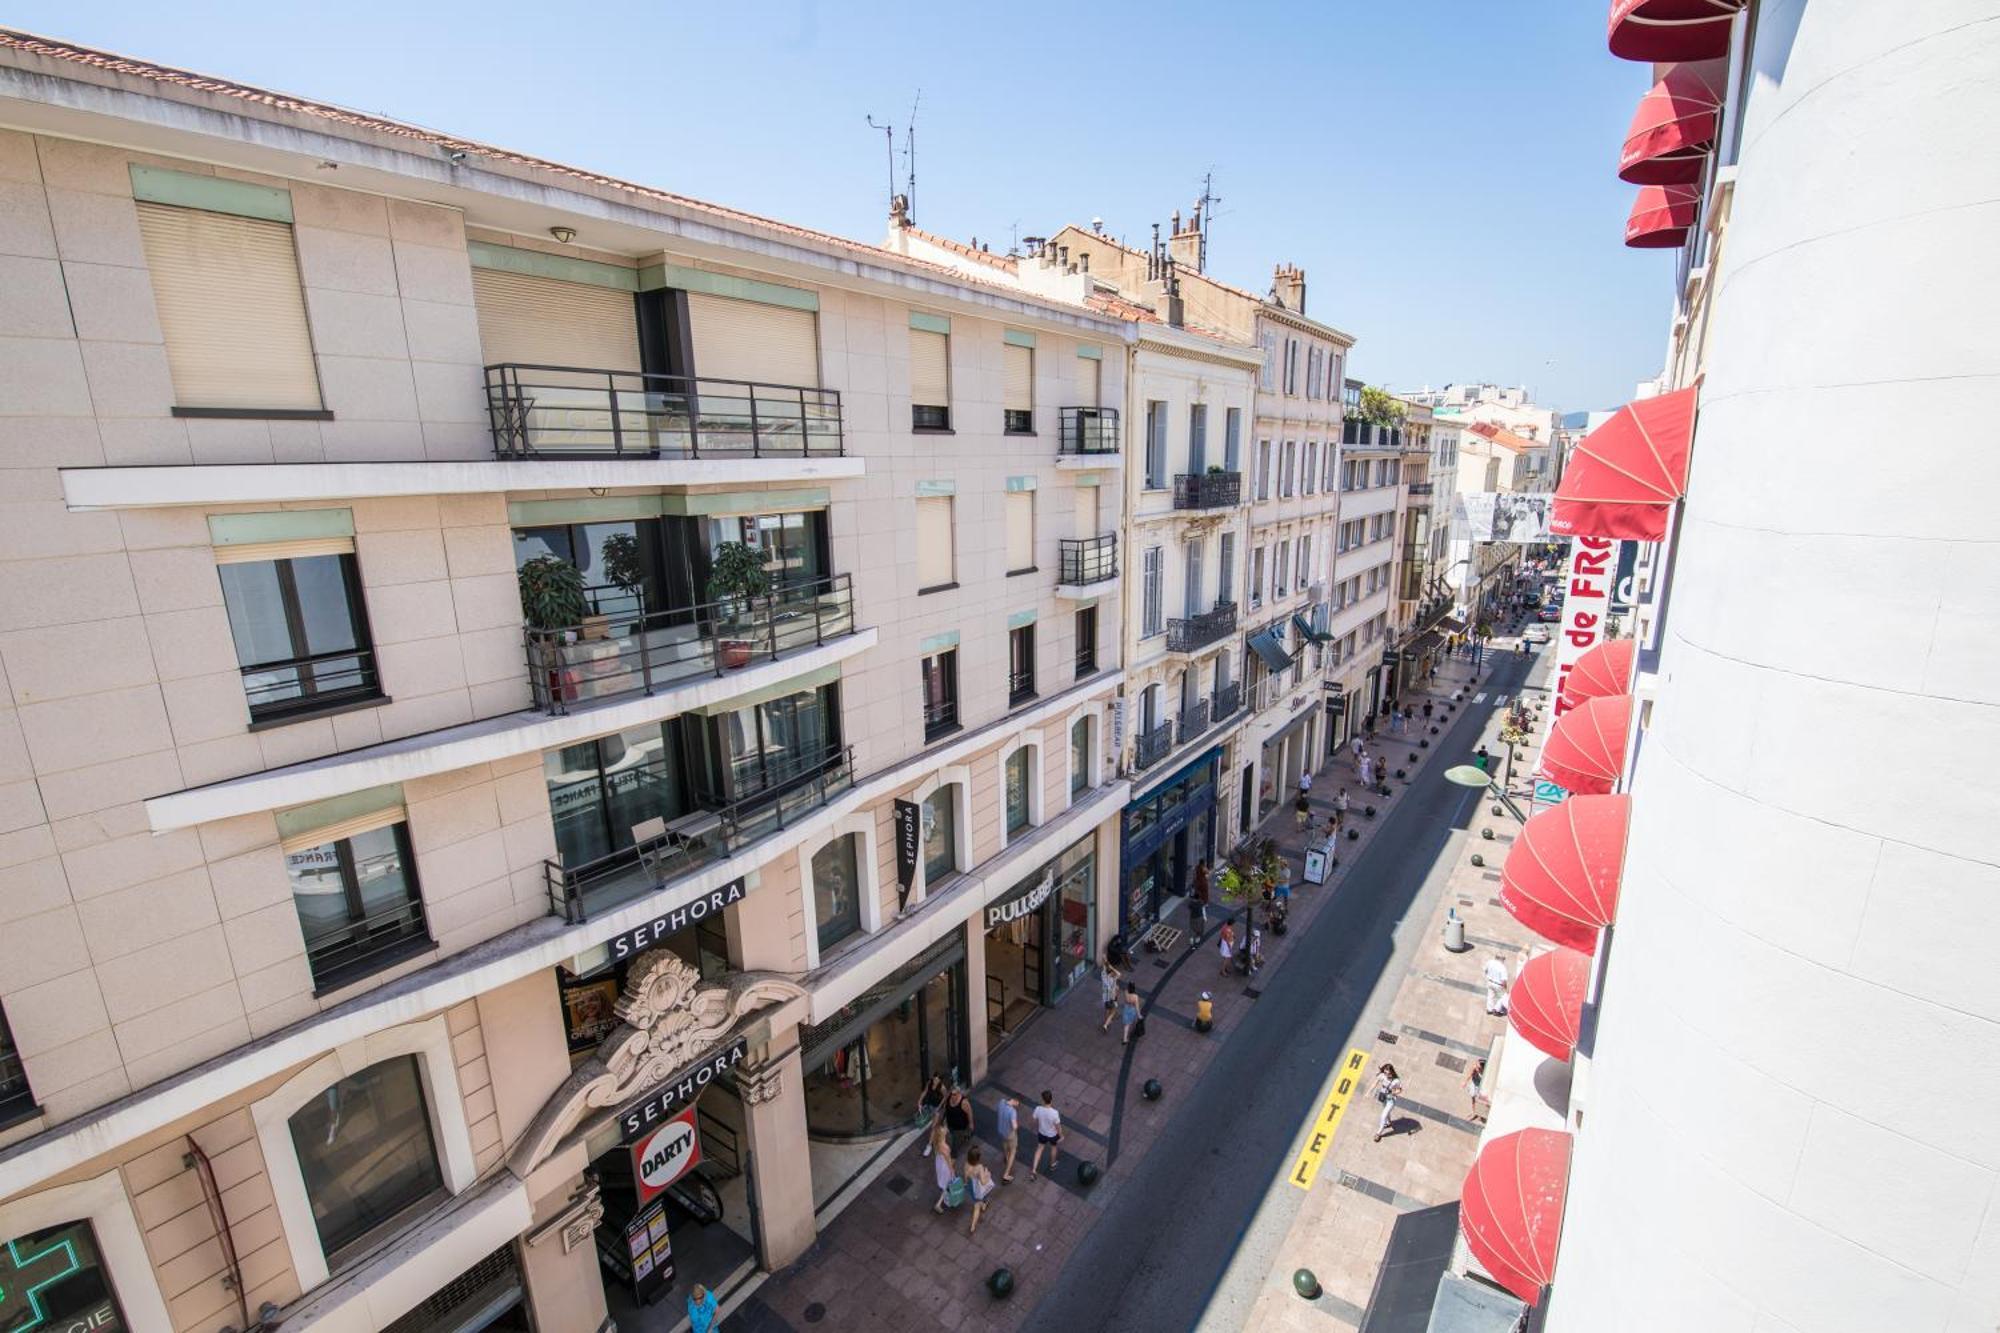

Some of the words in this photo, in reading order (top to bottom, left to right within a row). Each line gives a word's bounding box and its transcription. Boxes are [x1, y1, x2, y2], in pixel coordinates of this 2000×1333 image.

[905, 806, 915, 865] SEPHORA
[615, 884, 741, 958] SEPHORA
[627, 1046, 743, 1134] SEPHORA
[1296, 1053, 1363, 1184] HOTEL
[641, 1129, 692, 1180] DARTY
